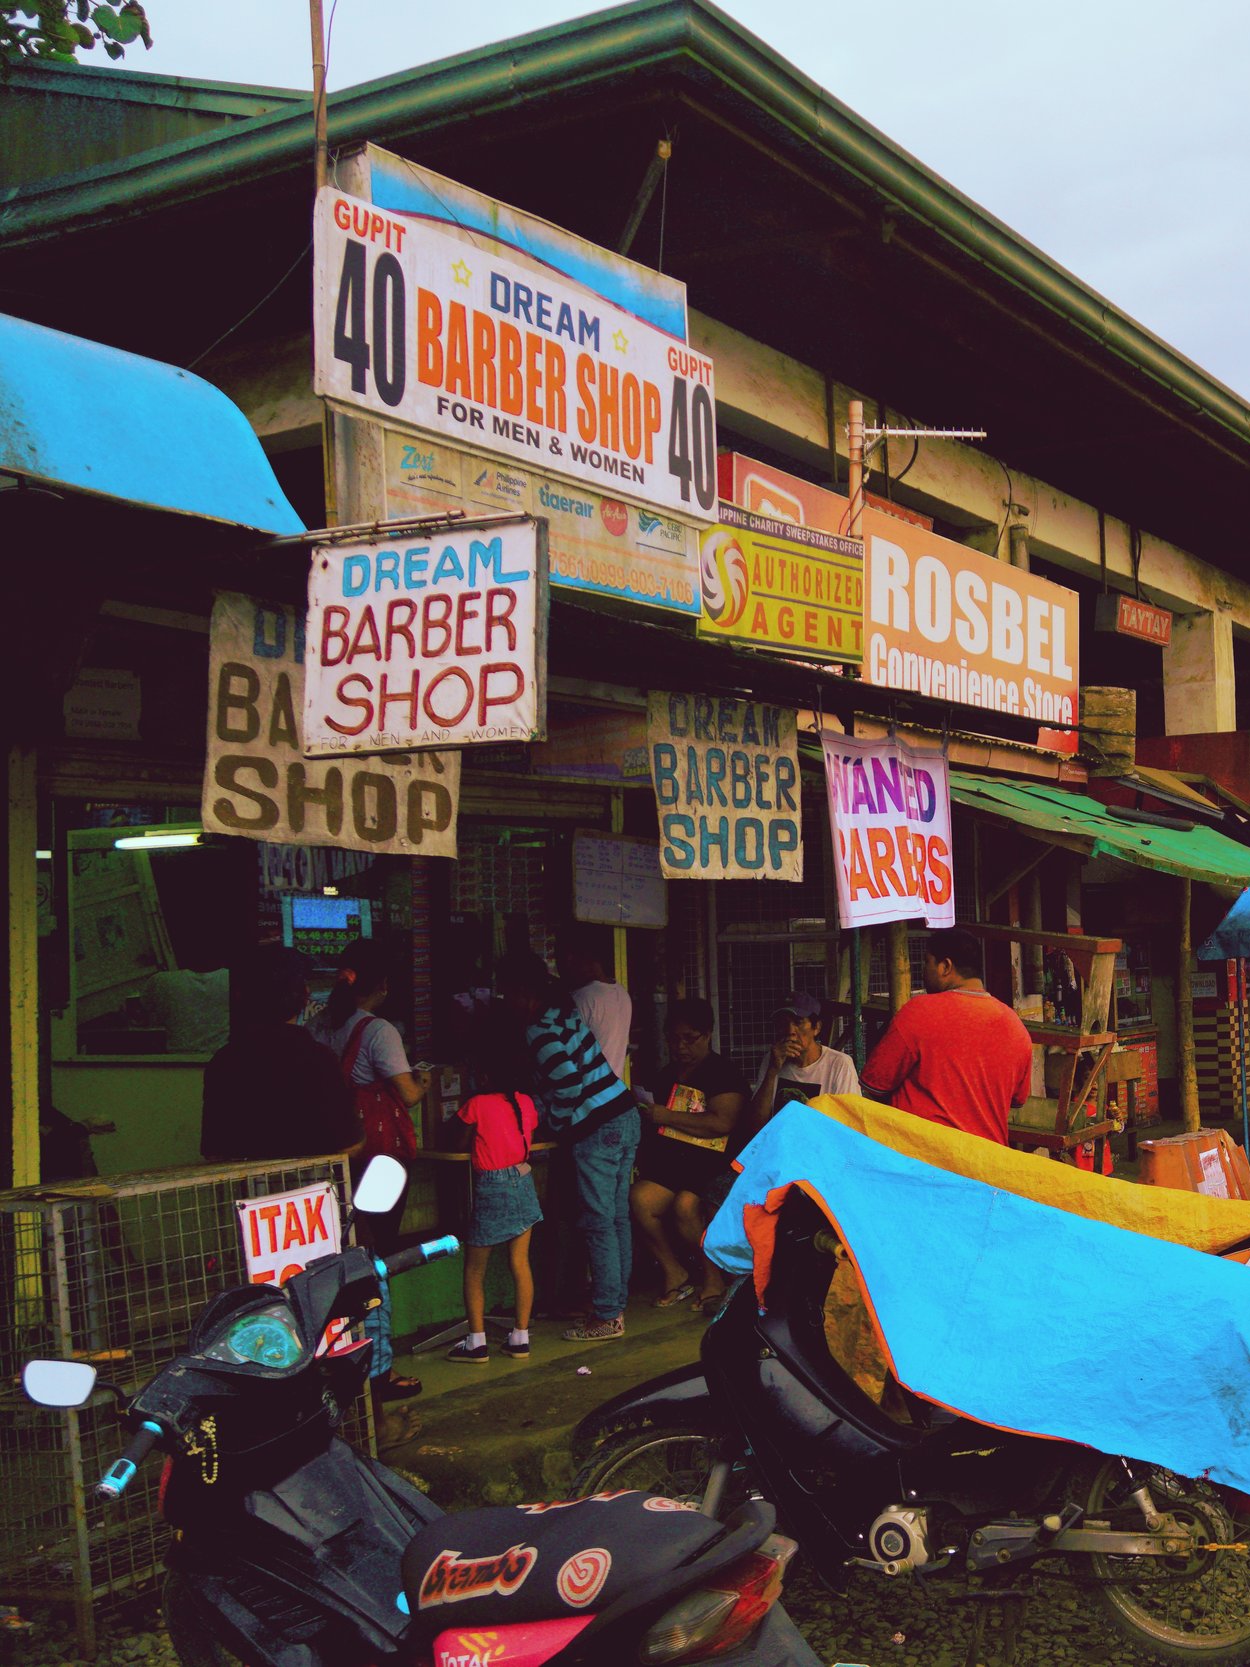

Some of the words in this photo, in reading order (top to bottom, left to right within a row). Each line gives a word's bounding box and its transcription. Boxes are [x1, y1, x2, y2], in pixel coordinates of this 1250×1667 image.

[333, 196, 407, 254] GUPIT
[333, 238, 406, 407] 40
[489, 270, 600, 353] DREAM
[417, 286, 567, 435] BARBER
[576, 351, 661, 466] SHOP
[667, 345, 713, 386] GUPIT
[436, 394, 485, 430] FOR
[492, 415, 541, 450] MEN
[547, 435, 564, 457] &
[569, 441, 646, 486] WOMEN
[667, 374, 715, 512] 40
[495, 482, 522, 498] Airlines
[496, 470, 528, 489] Philippine
[538, 482, 595, 519] tigerair
[719, 507, 748, 526] IPPINE
[749, 516, 785, 536] CHARITY
[785, 524, 839, 551] SWEEPSTAKES
[839, 541, 864, 557] OFFICE
[341, 536, 531, 598] DREAM
[752, 552, 863, 608] AUTHORIZED
[320, 587, 518, 667] BARBER
[751, 602, 863, 652] AGENT
[870, 534, 1074, 682] ROSBEL
[1122, 603, 1169, 638] TAYTAY
[323, 662, 526, 736] SHOP
[869, 632, 1020, 715] Convenience
[1023, 677, 1073, 736] Store
[320, 735, 349, 750] FOR
[369, 731, 401, 747] MEN
[420, 728, 452, 743] AND
[470, 726, 532, 741] WOMEN
[668, 692, 781, 748] DREAM
[212, 754, 453, 845] SHOP
[652, 743, 798, 812] BARBER
[826, 752, 937, 823] WANED
[663, 813, 799, 871] SHOP
[249, 1194, 329, 1257] ITAK
